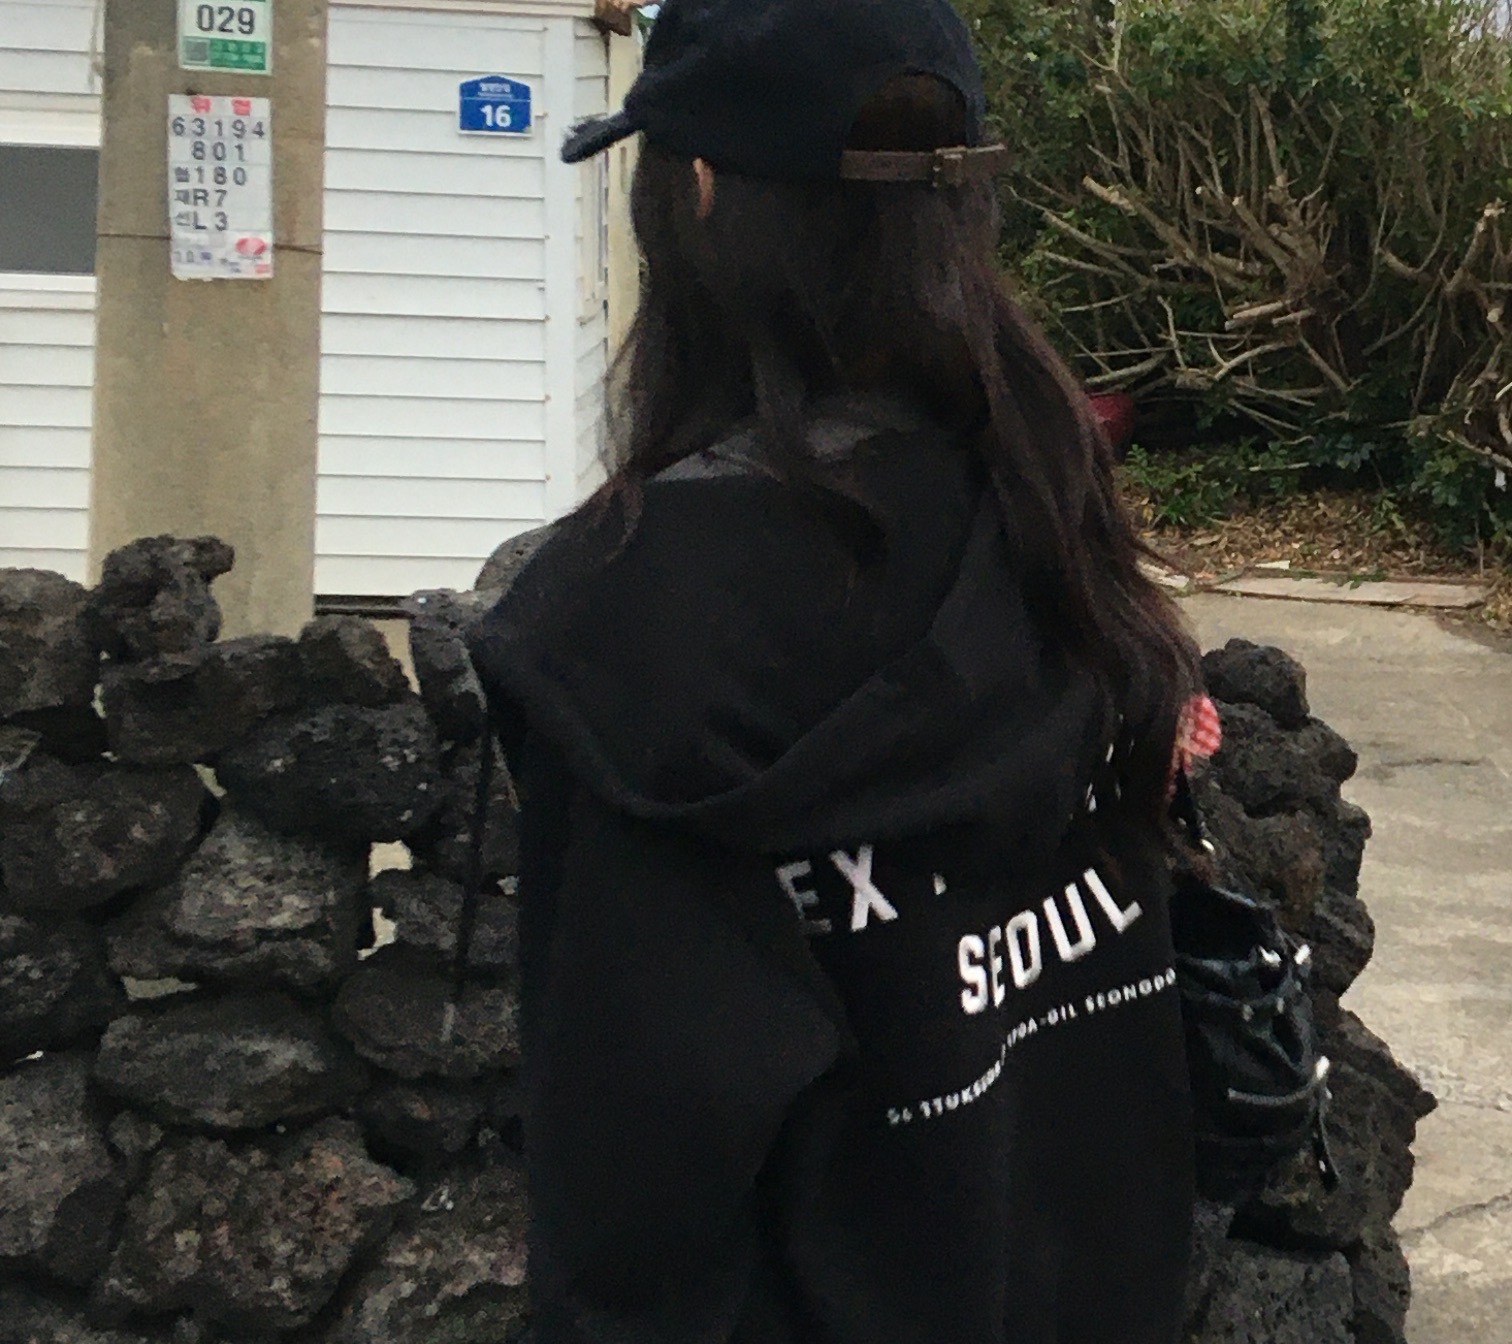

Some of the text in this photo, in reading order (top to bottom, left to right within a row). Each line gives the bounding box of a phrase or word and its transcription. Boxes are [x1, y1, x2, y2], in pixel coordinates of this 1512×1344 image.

[197, 4, 255, 35] 029
[480, 104, 512, 127] 16
[172, 116, 266, 139] 63194
[191, 141, 245, 162] 801
[957, 867, 1143, 1015] SEOUL
